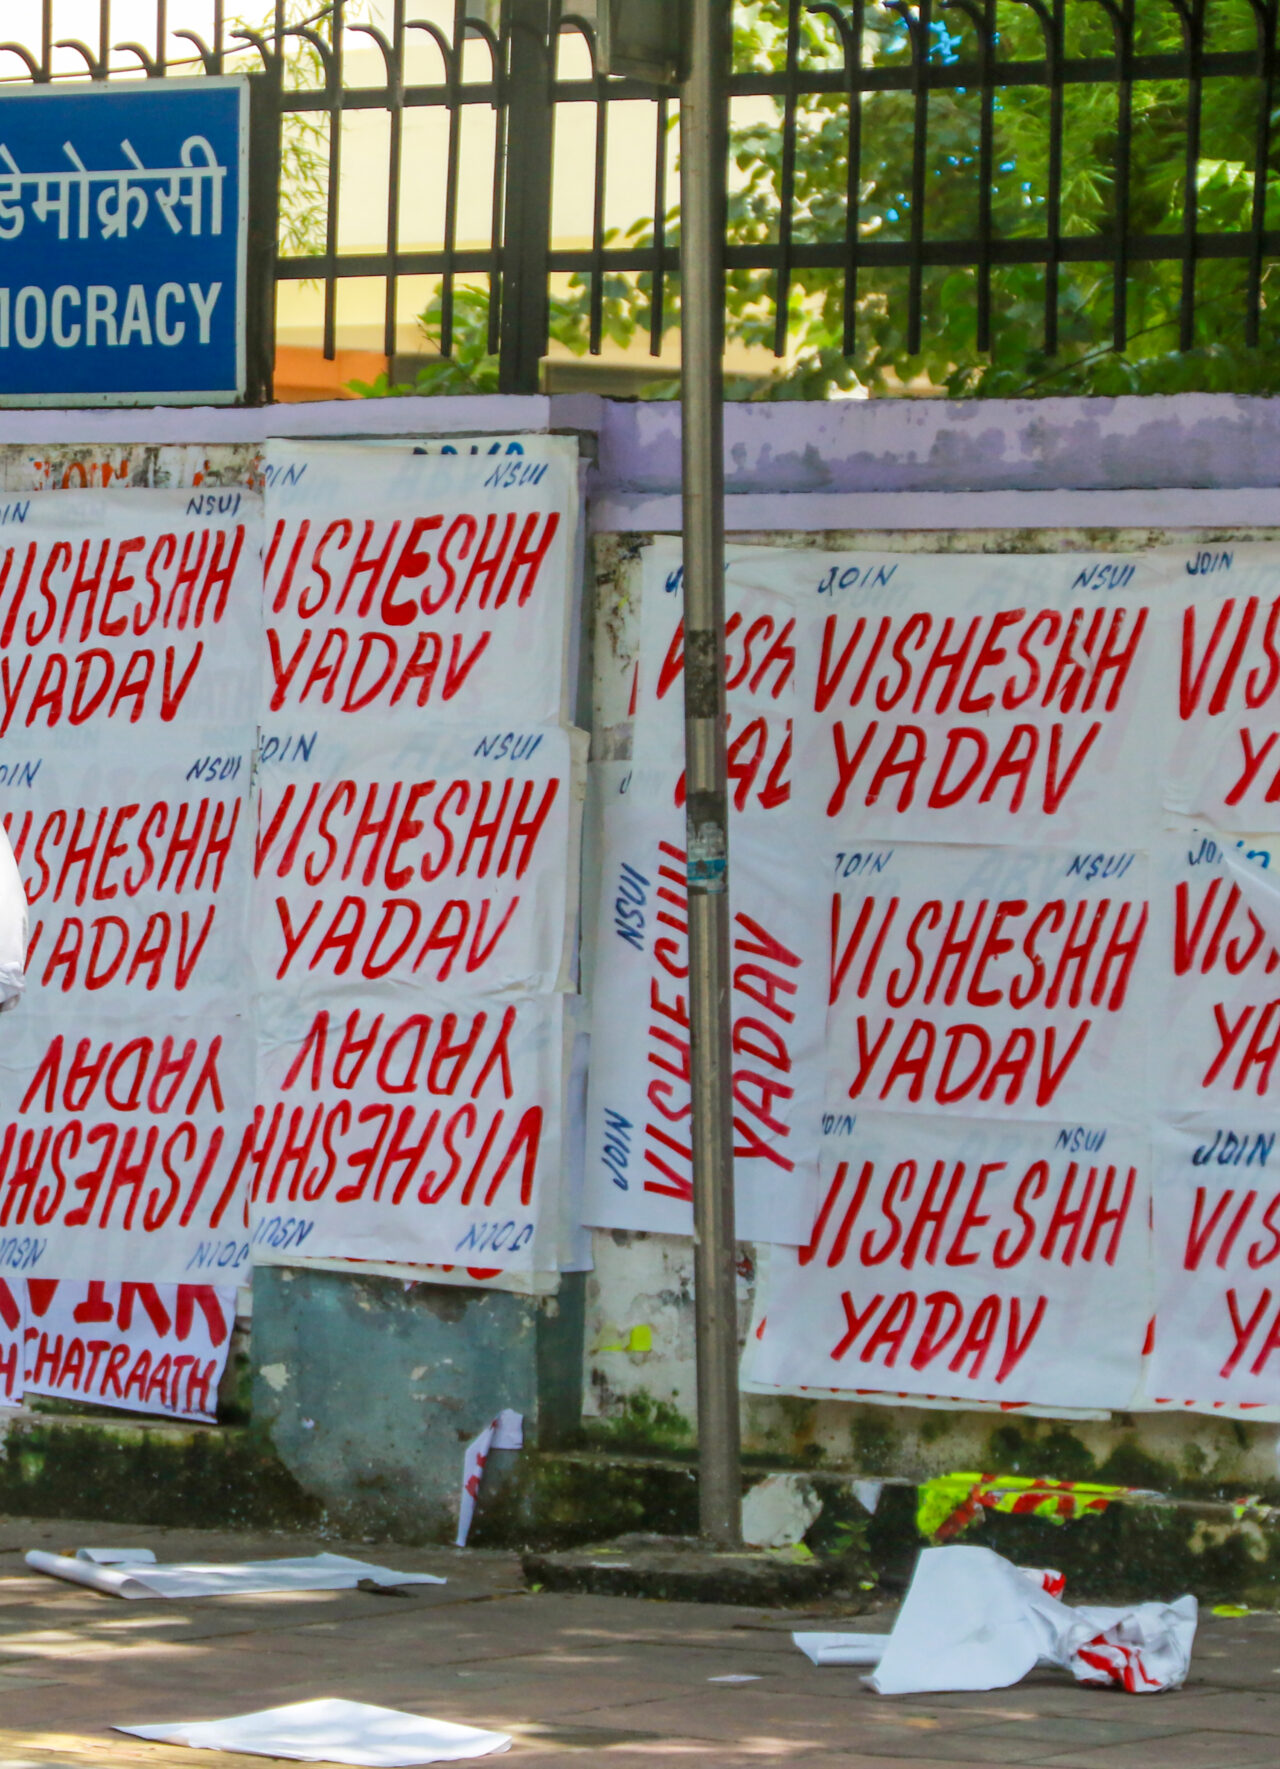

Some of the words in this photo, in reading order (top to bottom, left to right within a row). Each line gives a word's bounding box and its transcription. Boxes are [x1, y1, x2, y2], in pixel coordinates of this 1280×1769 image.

[186, 493, 241, 516] NSUI
[483, 462, 549, 488] NSUI
[818, 564, 898, 596] JOIN
[1072, 563, 1136, 590] NSUI
[1186, 551, 1234, 576] JOIN
[265, 628, 492, 713] YADAV
[814, 606, 1150, 715] VISHESHH
[186, 755, 242, 782] NSUI
[472, 734, 544, 761] NSUI
[826, 721, 1103, 817] YADAV
[254, 777, 560, 890] VISHESHH
[1066, 853, 1135, 881] NSUI
[273, 896, 520, 981] YADAV
[615, 862, 651, 951] NSUI
[830, 892, 1149, 1013] VISHESHH
[19, 1034, 224, 1115] YADAV
[280, 1005, 517, 1100] YADAV
[731, 911, 803, 1173] YADAV
[848, 1014, 1093, 1107] YADAV
[251, 1099, 543, 1207] VISHESHH
[599, 1107, 634, 1191] JOIN
[1055, 1127, 1107, 1153] NSUI
[1192, 1129, 1276, 1167] JOIN
[186, 1240, 249, 1271] JOIN
[253, 1216, 314, 1248] NSUI
[455, 1222, 535, 1252] JOIN
[23, 1326, 218, 1413] CHATRAATH
[830, 1290, 1049, 1385] YADAV
